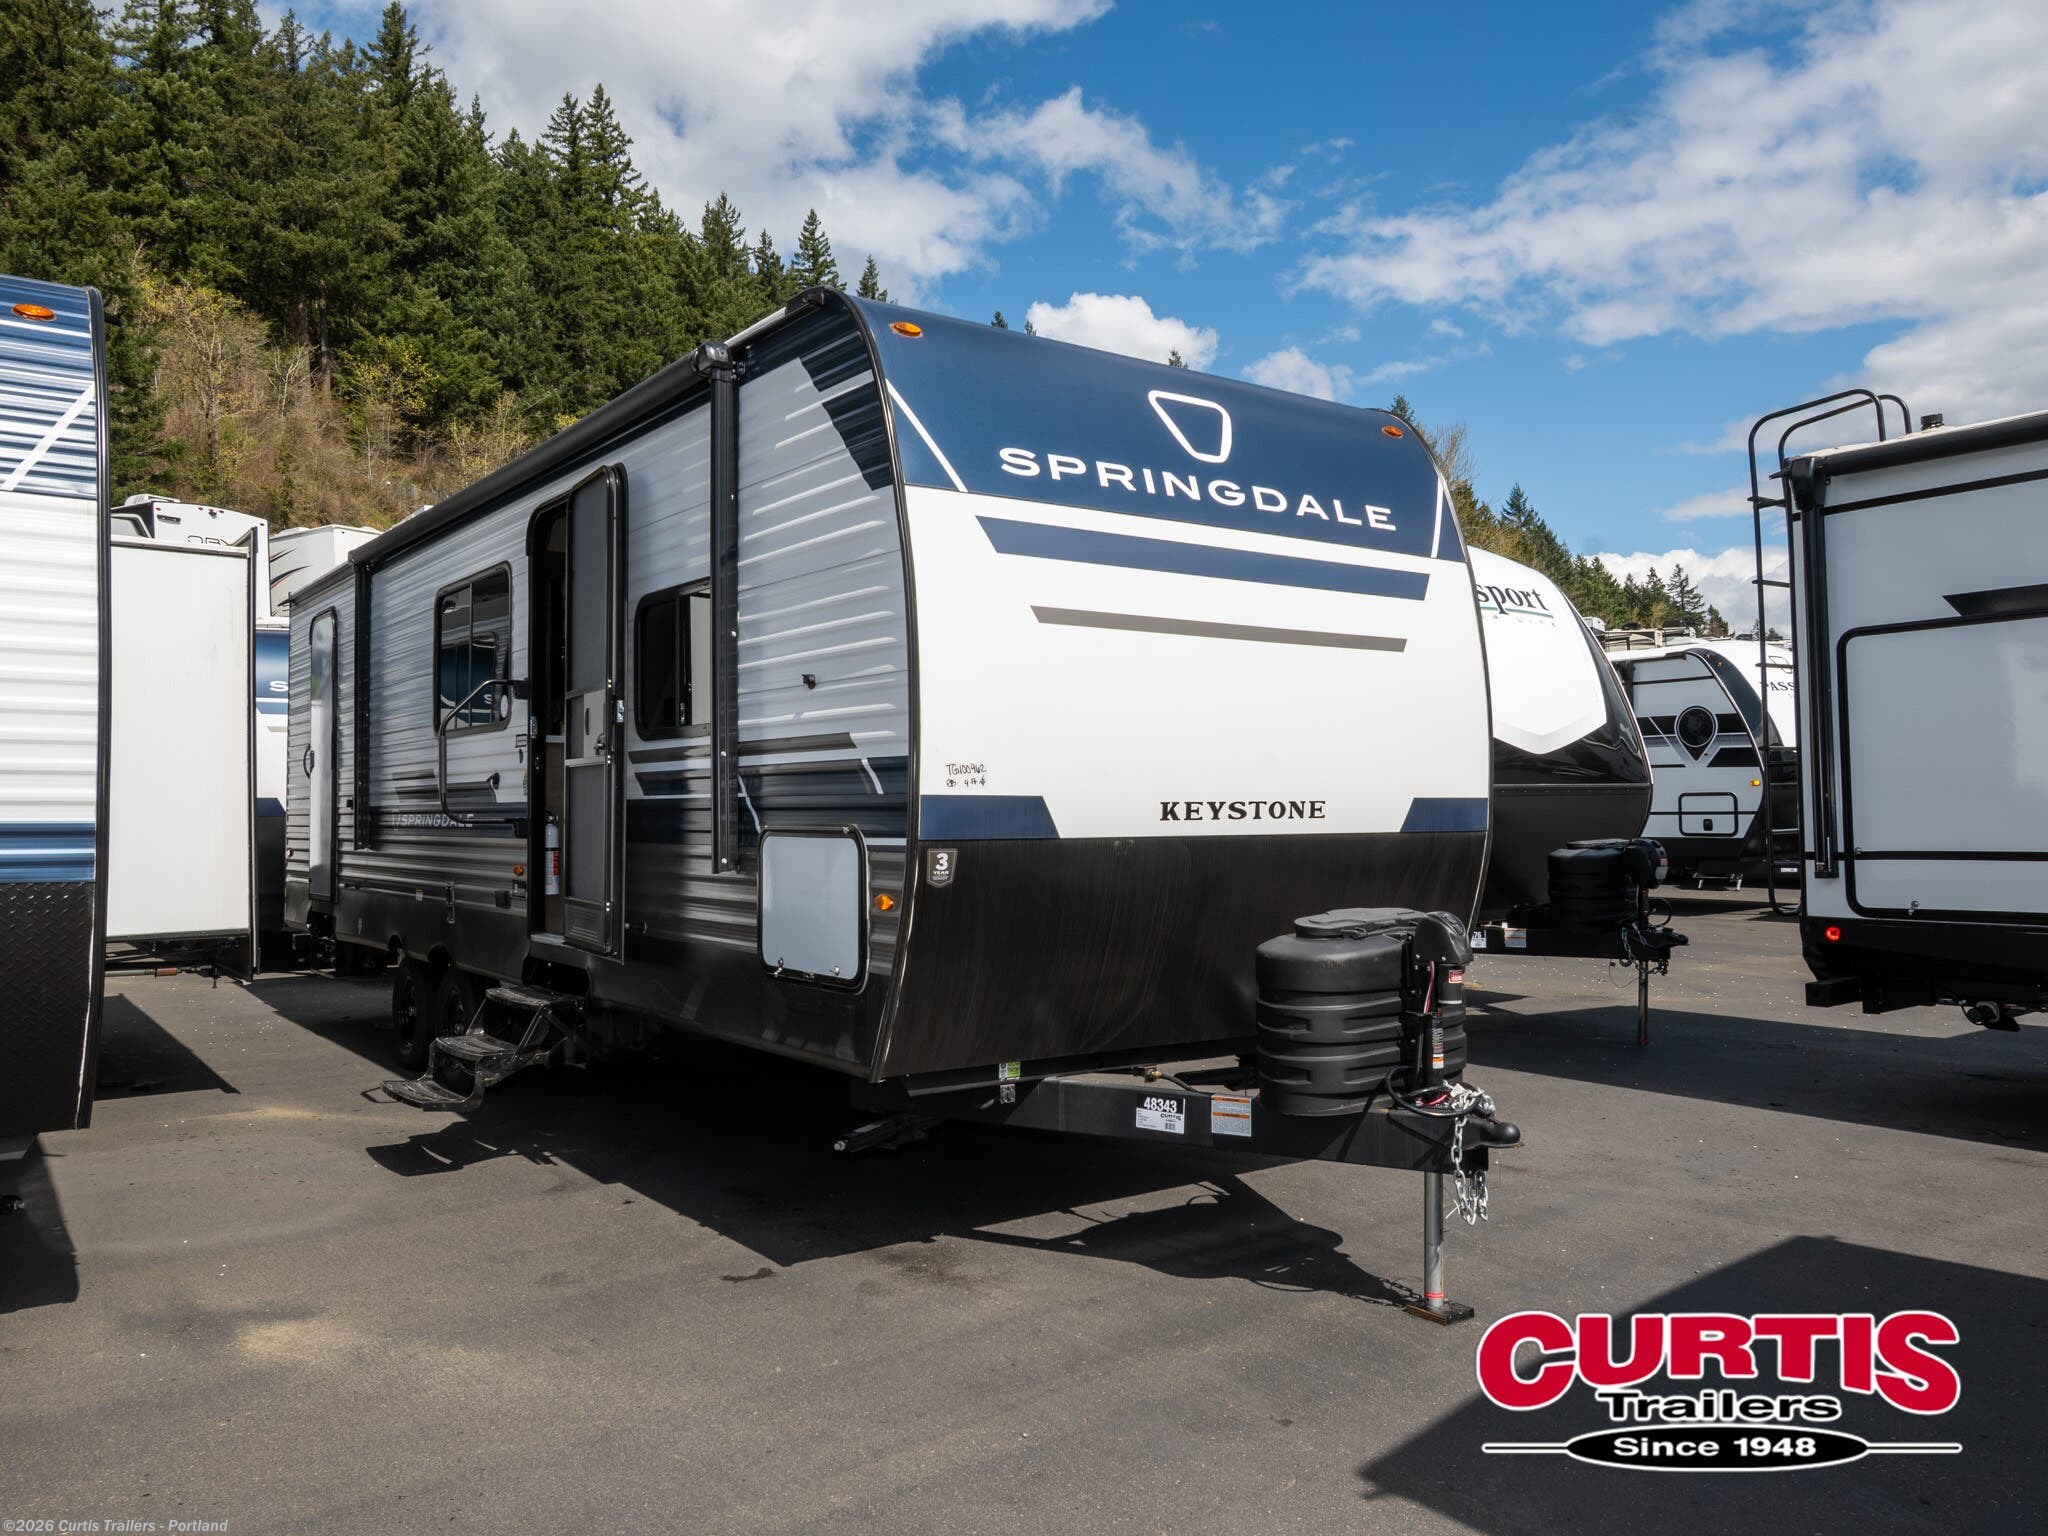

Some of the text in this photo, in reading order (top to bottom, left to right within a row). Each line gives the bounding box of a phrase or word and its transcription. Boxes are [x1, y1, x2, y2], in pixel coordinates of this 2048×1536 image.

[998, 446, 1398, 532] SPRINGDALE
[1159, 800, 1326, 821] KEYSTONE
[935, 852, 949, 871] 3
[1143, 1096, 1178, 1114] 48343
